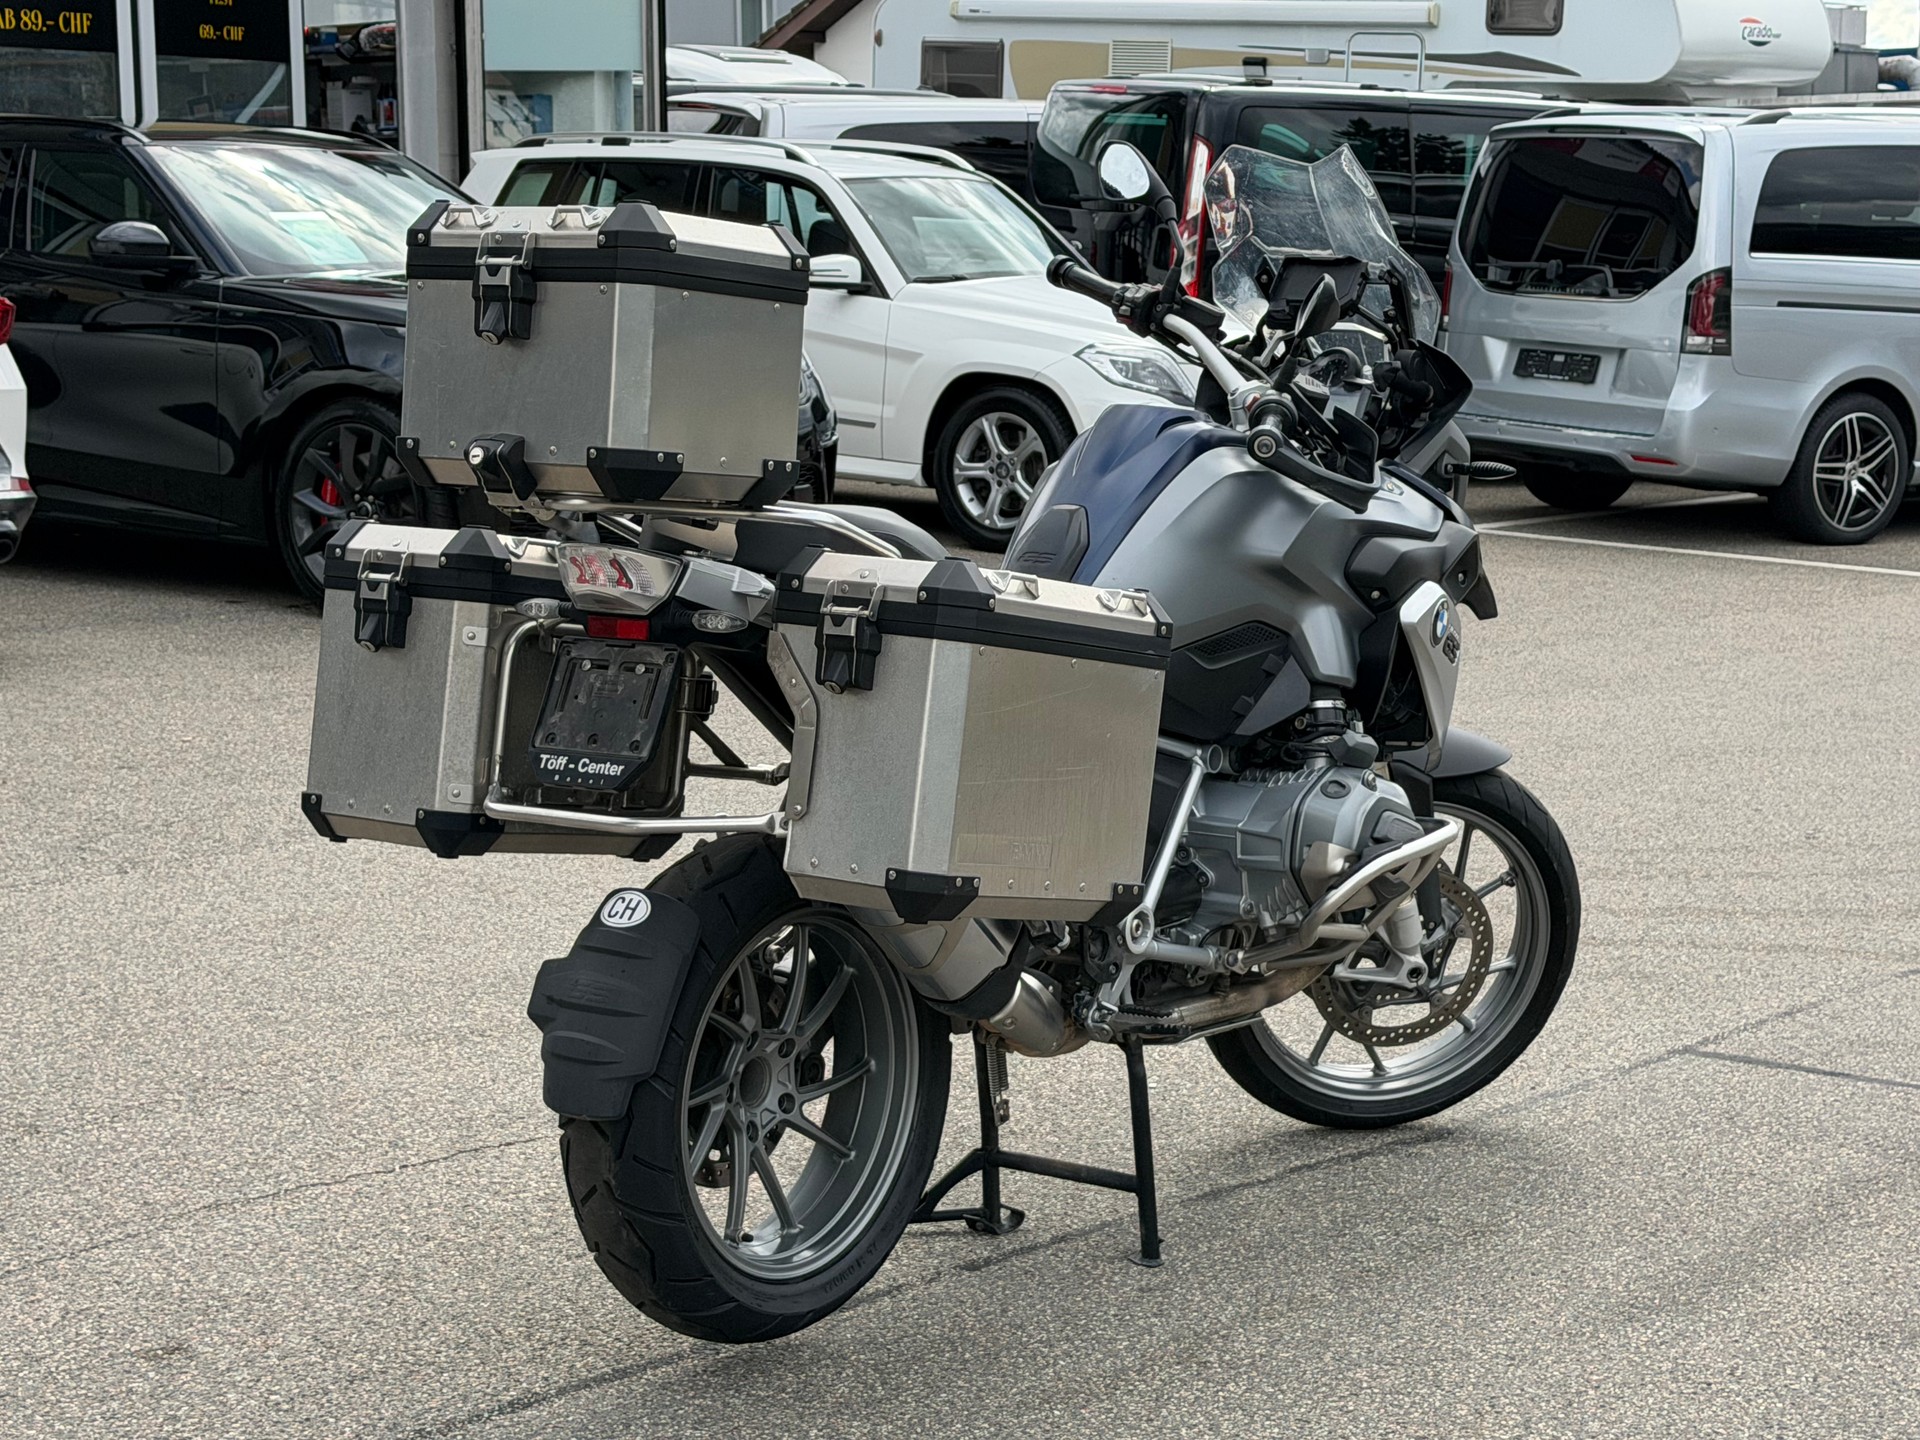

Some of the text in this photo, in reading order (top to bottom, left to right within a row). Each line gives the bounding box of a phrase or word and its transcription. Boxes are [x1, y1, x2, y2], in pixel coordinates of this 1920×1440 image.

[20, 8, 55, 32] 89.-
[59, 11, 93, 34] CHF
[199, 23, 245, 41] 69.- CHF
[540, 753, 569, 771] Töff
[577, 757, 625, 776] Center
[607, 896, 642, 921] CH
